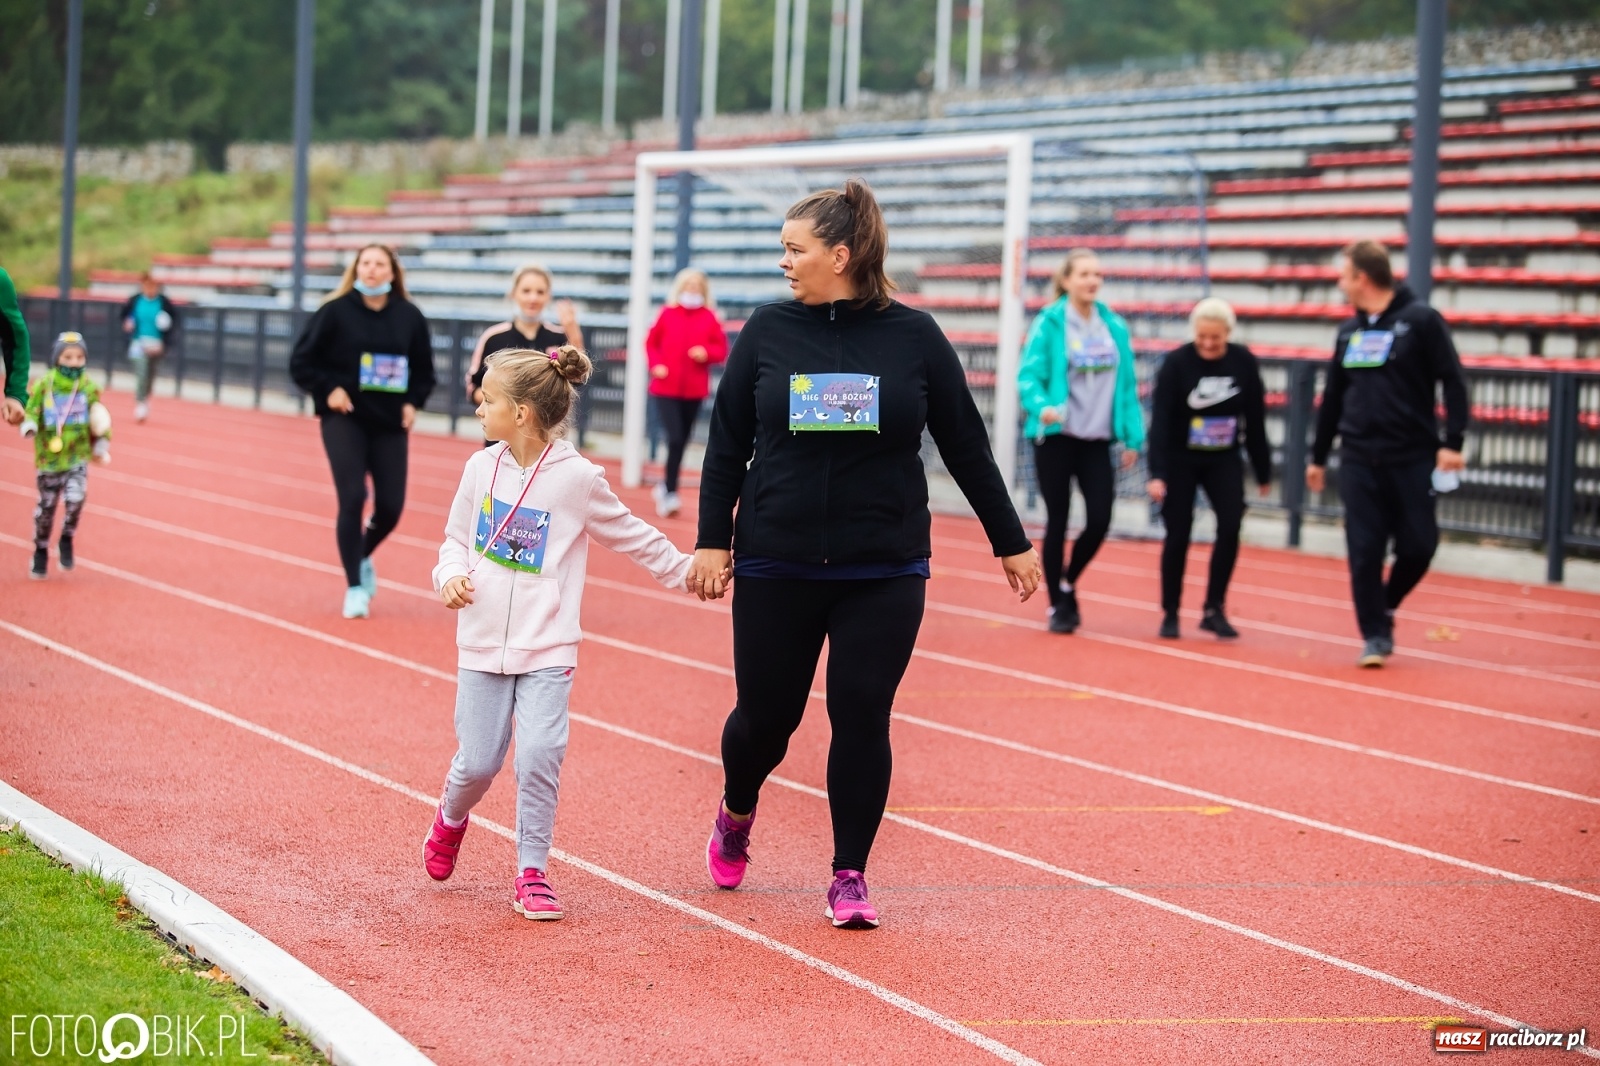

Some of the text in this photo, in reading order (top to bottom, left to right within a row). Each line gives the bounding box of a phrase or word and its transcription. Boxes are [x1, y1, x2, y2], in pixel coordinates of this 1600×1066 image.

[823, 393, 838, 401] DLA
[843, 409, 870, 422] 261
[505, 548, 535, 564] 264
